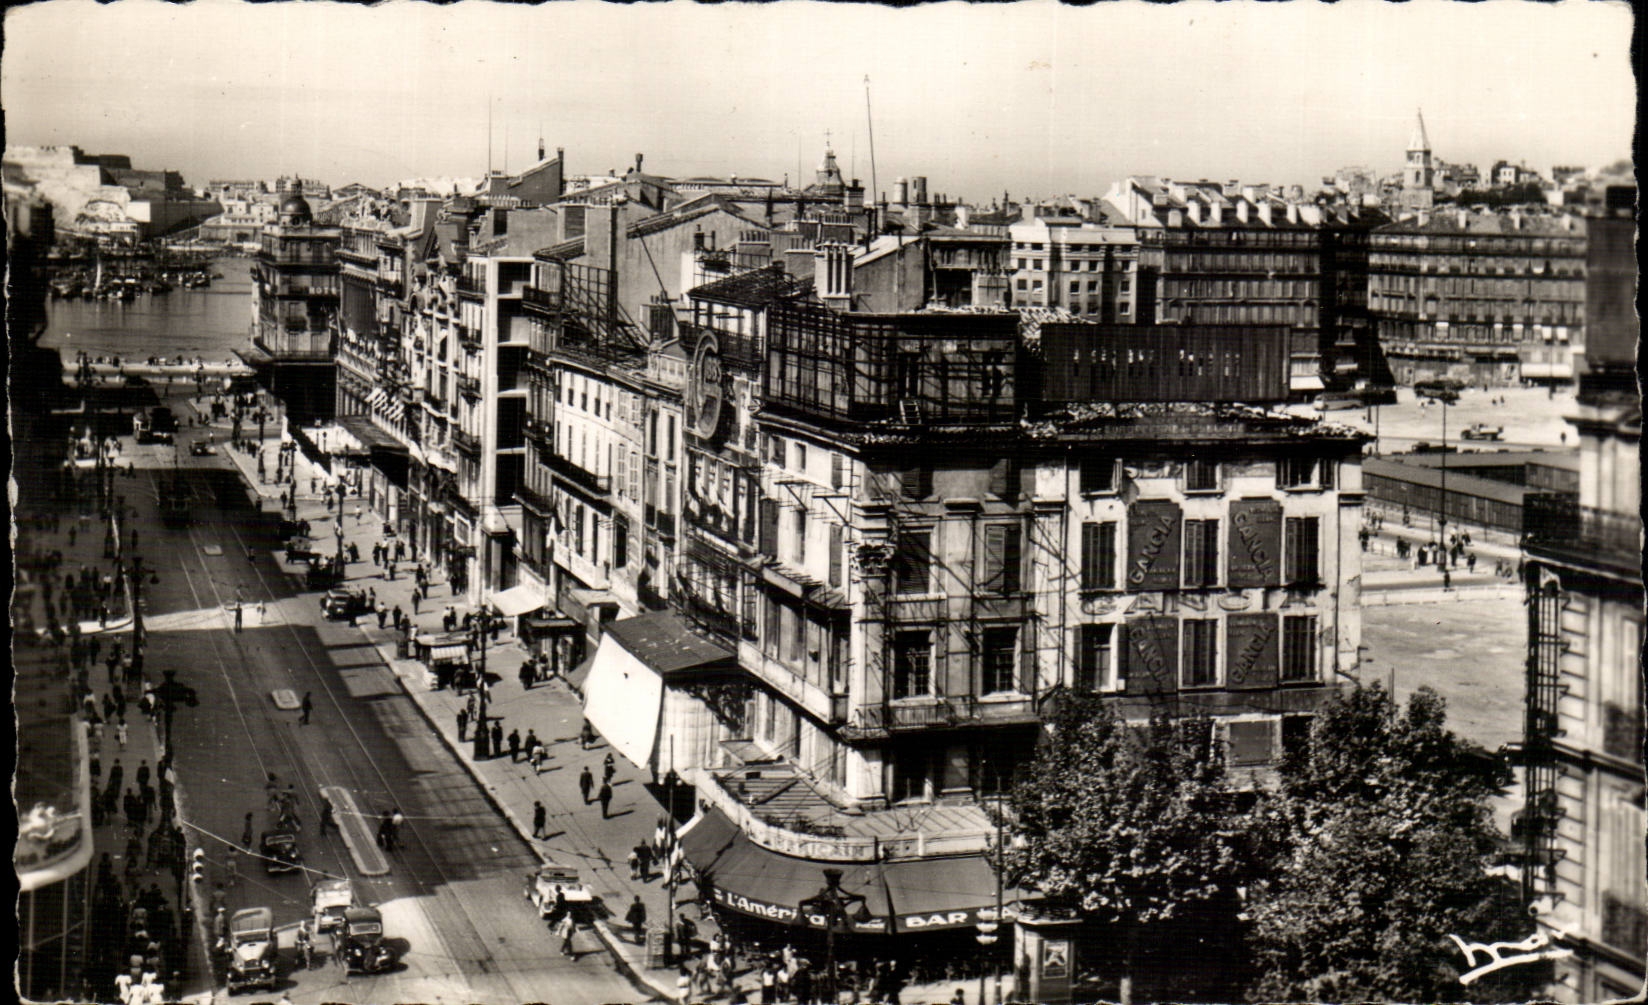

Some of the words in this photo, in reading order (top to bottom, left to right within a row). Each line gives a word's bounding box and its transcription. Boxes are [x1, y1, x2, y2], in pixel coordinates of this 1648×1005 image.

[1129, 515, 1176, 584] GANCIA
[1234, 510, 1274, 583] GANCIA
[1081, 589, 1316, 615] GANCIA
[905, 911, 968, 928] BAR
